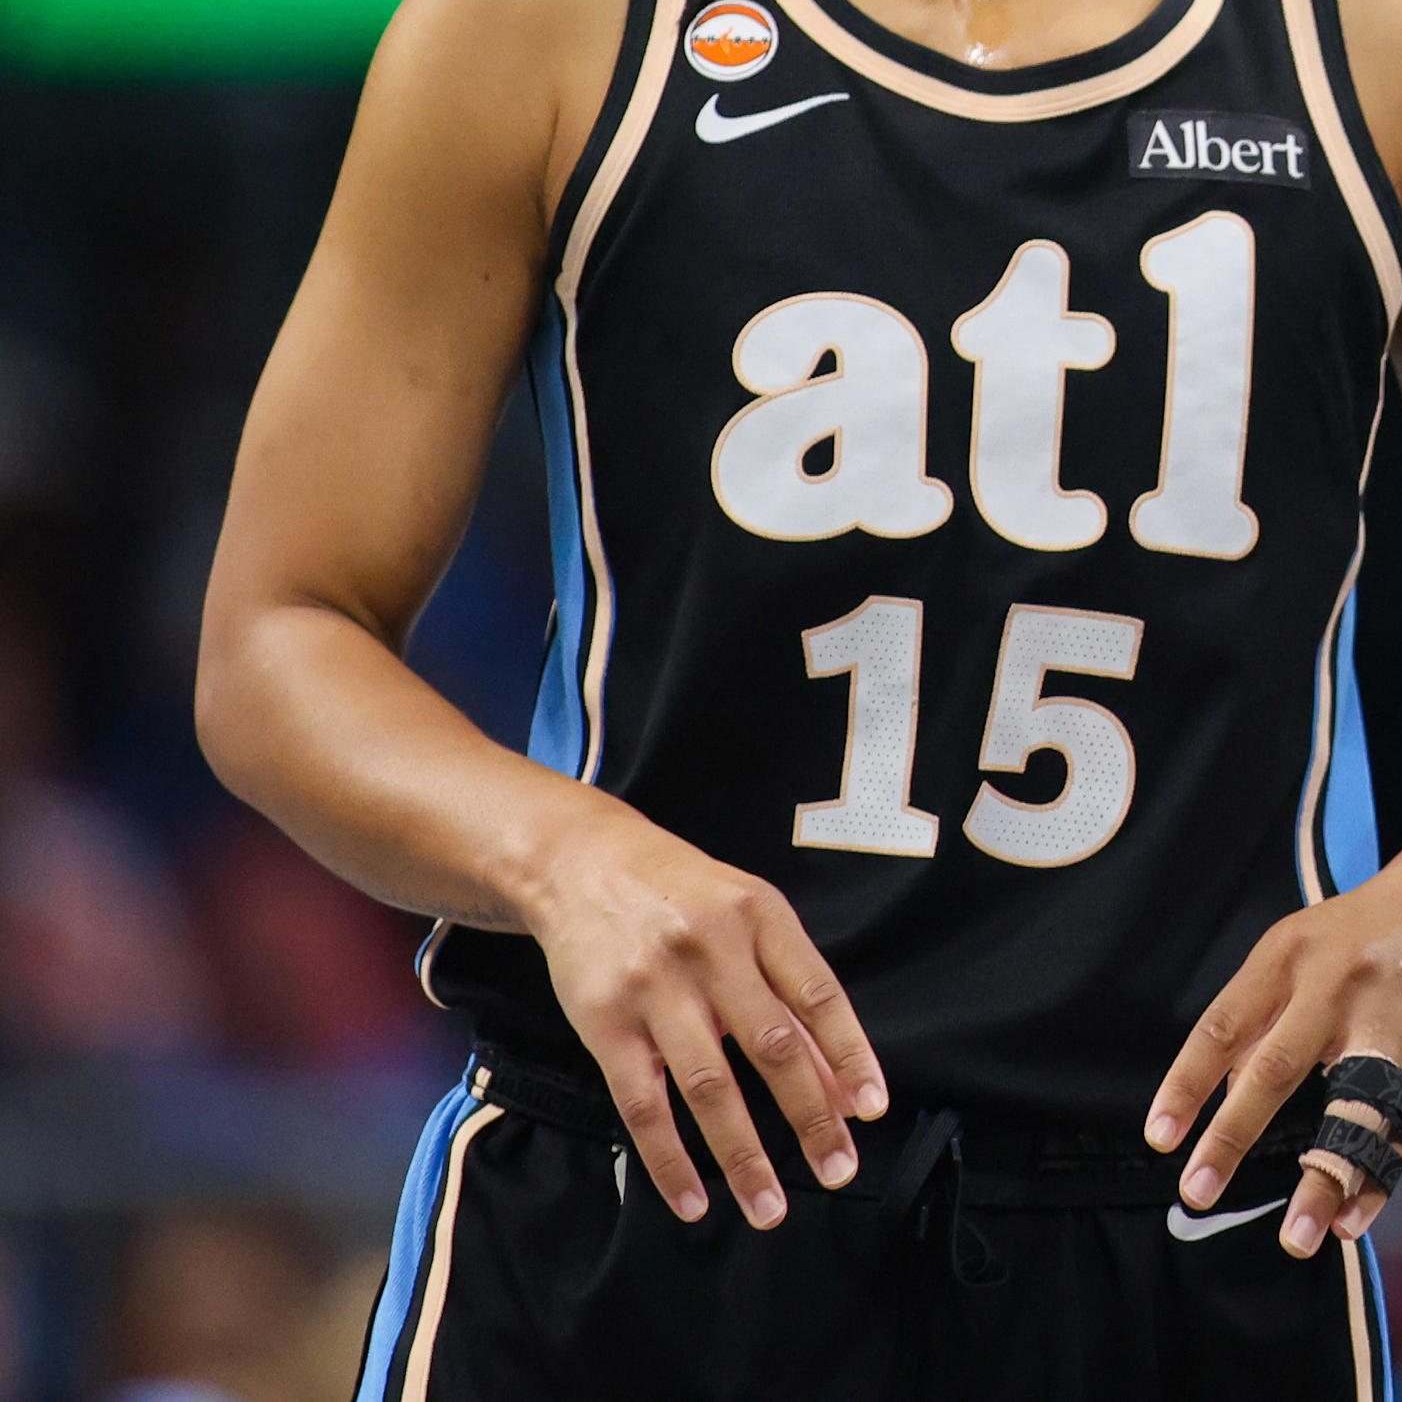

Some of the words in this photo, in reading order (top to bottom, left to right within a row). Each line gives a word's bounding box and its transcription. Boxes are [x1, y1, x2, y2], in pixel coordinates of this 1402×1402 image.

[1138, 119, 1304, 179] Albert
[711, 210, 1259, 562] atl
[792, 595, 1145, 868] 15
